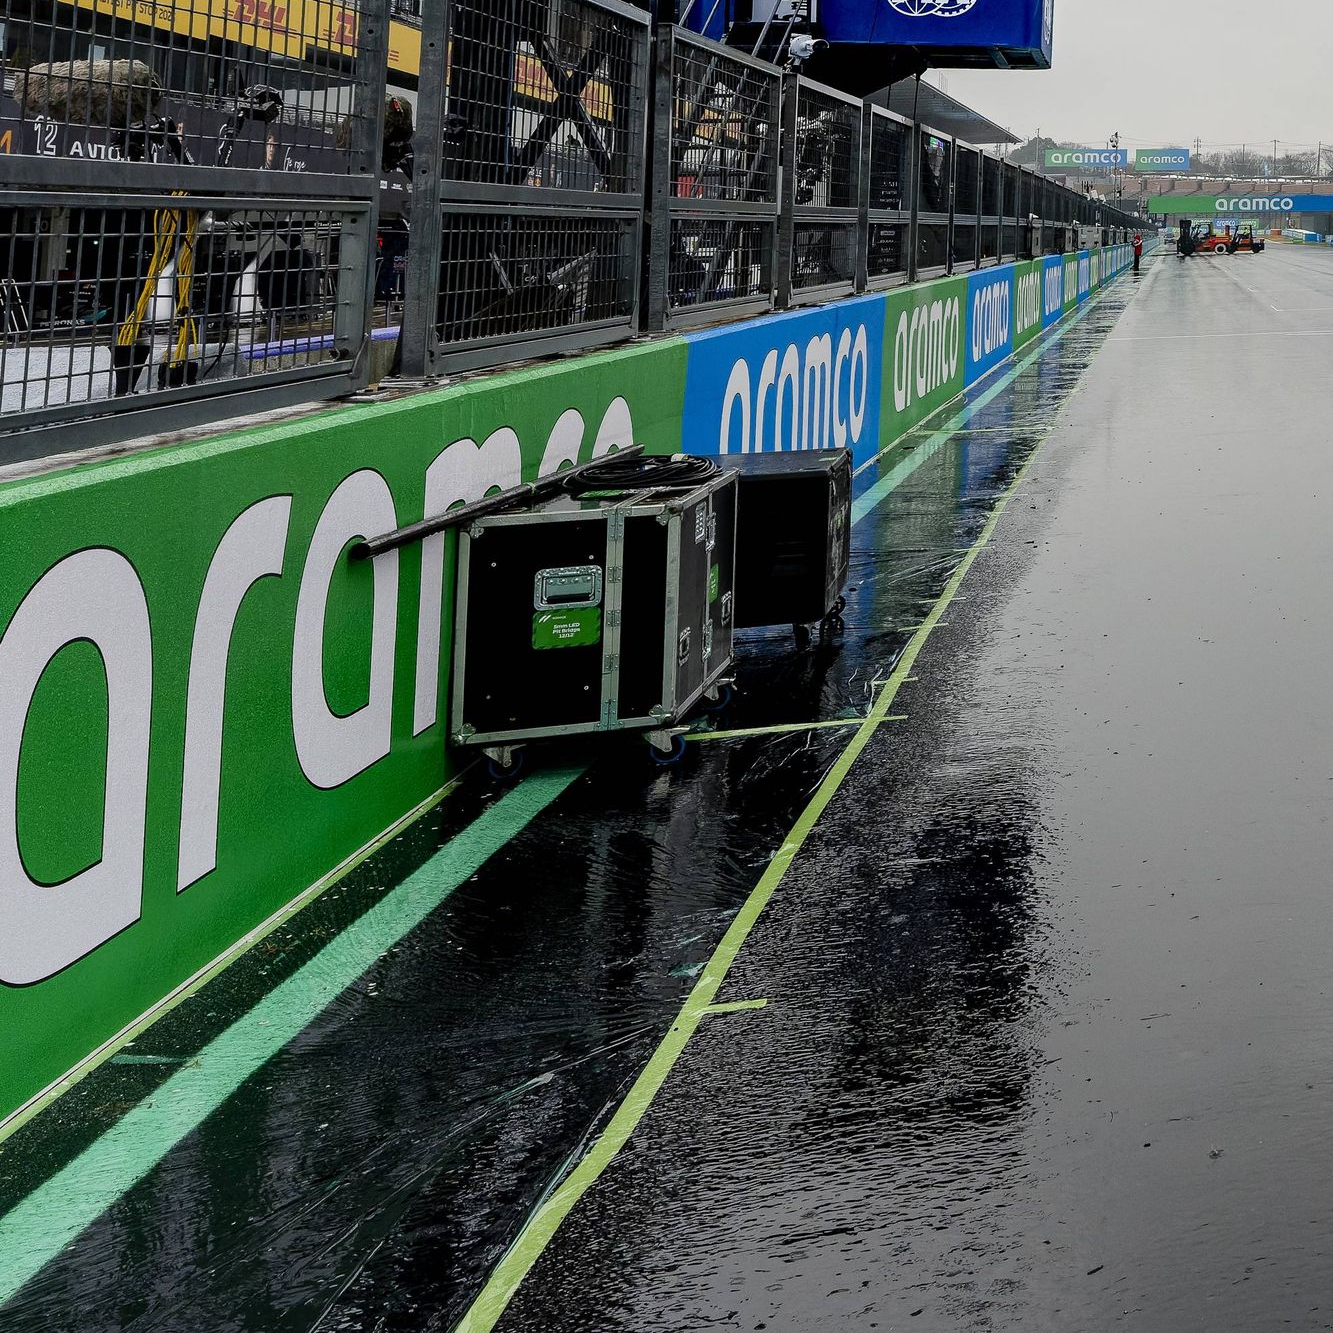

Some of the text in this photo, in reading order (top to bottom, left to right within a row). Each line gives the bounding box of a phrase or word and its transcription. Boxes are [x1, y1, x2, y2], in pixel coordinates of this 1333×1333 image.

[1051, 152, 1121, 164] aramco
[1140, 155, 1185, 164] aramco
[1215, 197, 1294, 211] aramco
[972, 280, 1009, 363] aramco
[893, 296, 959, 413] aramco
[719, 323, 867, 455] aramco
